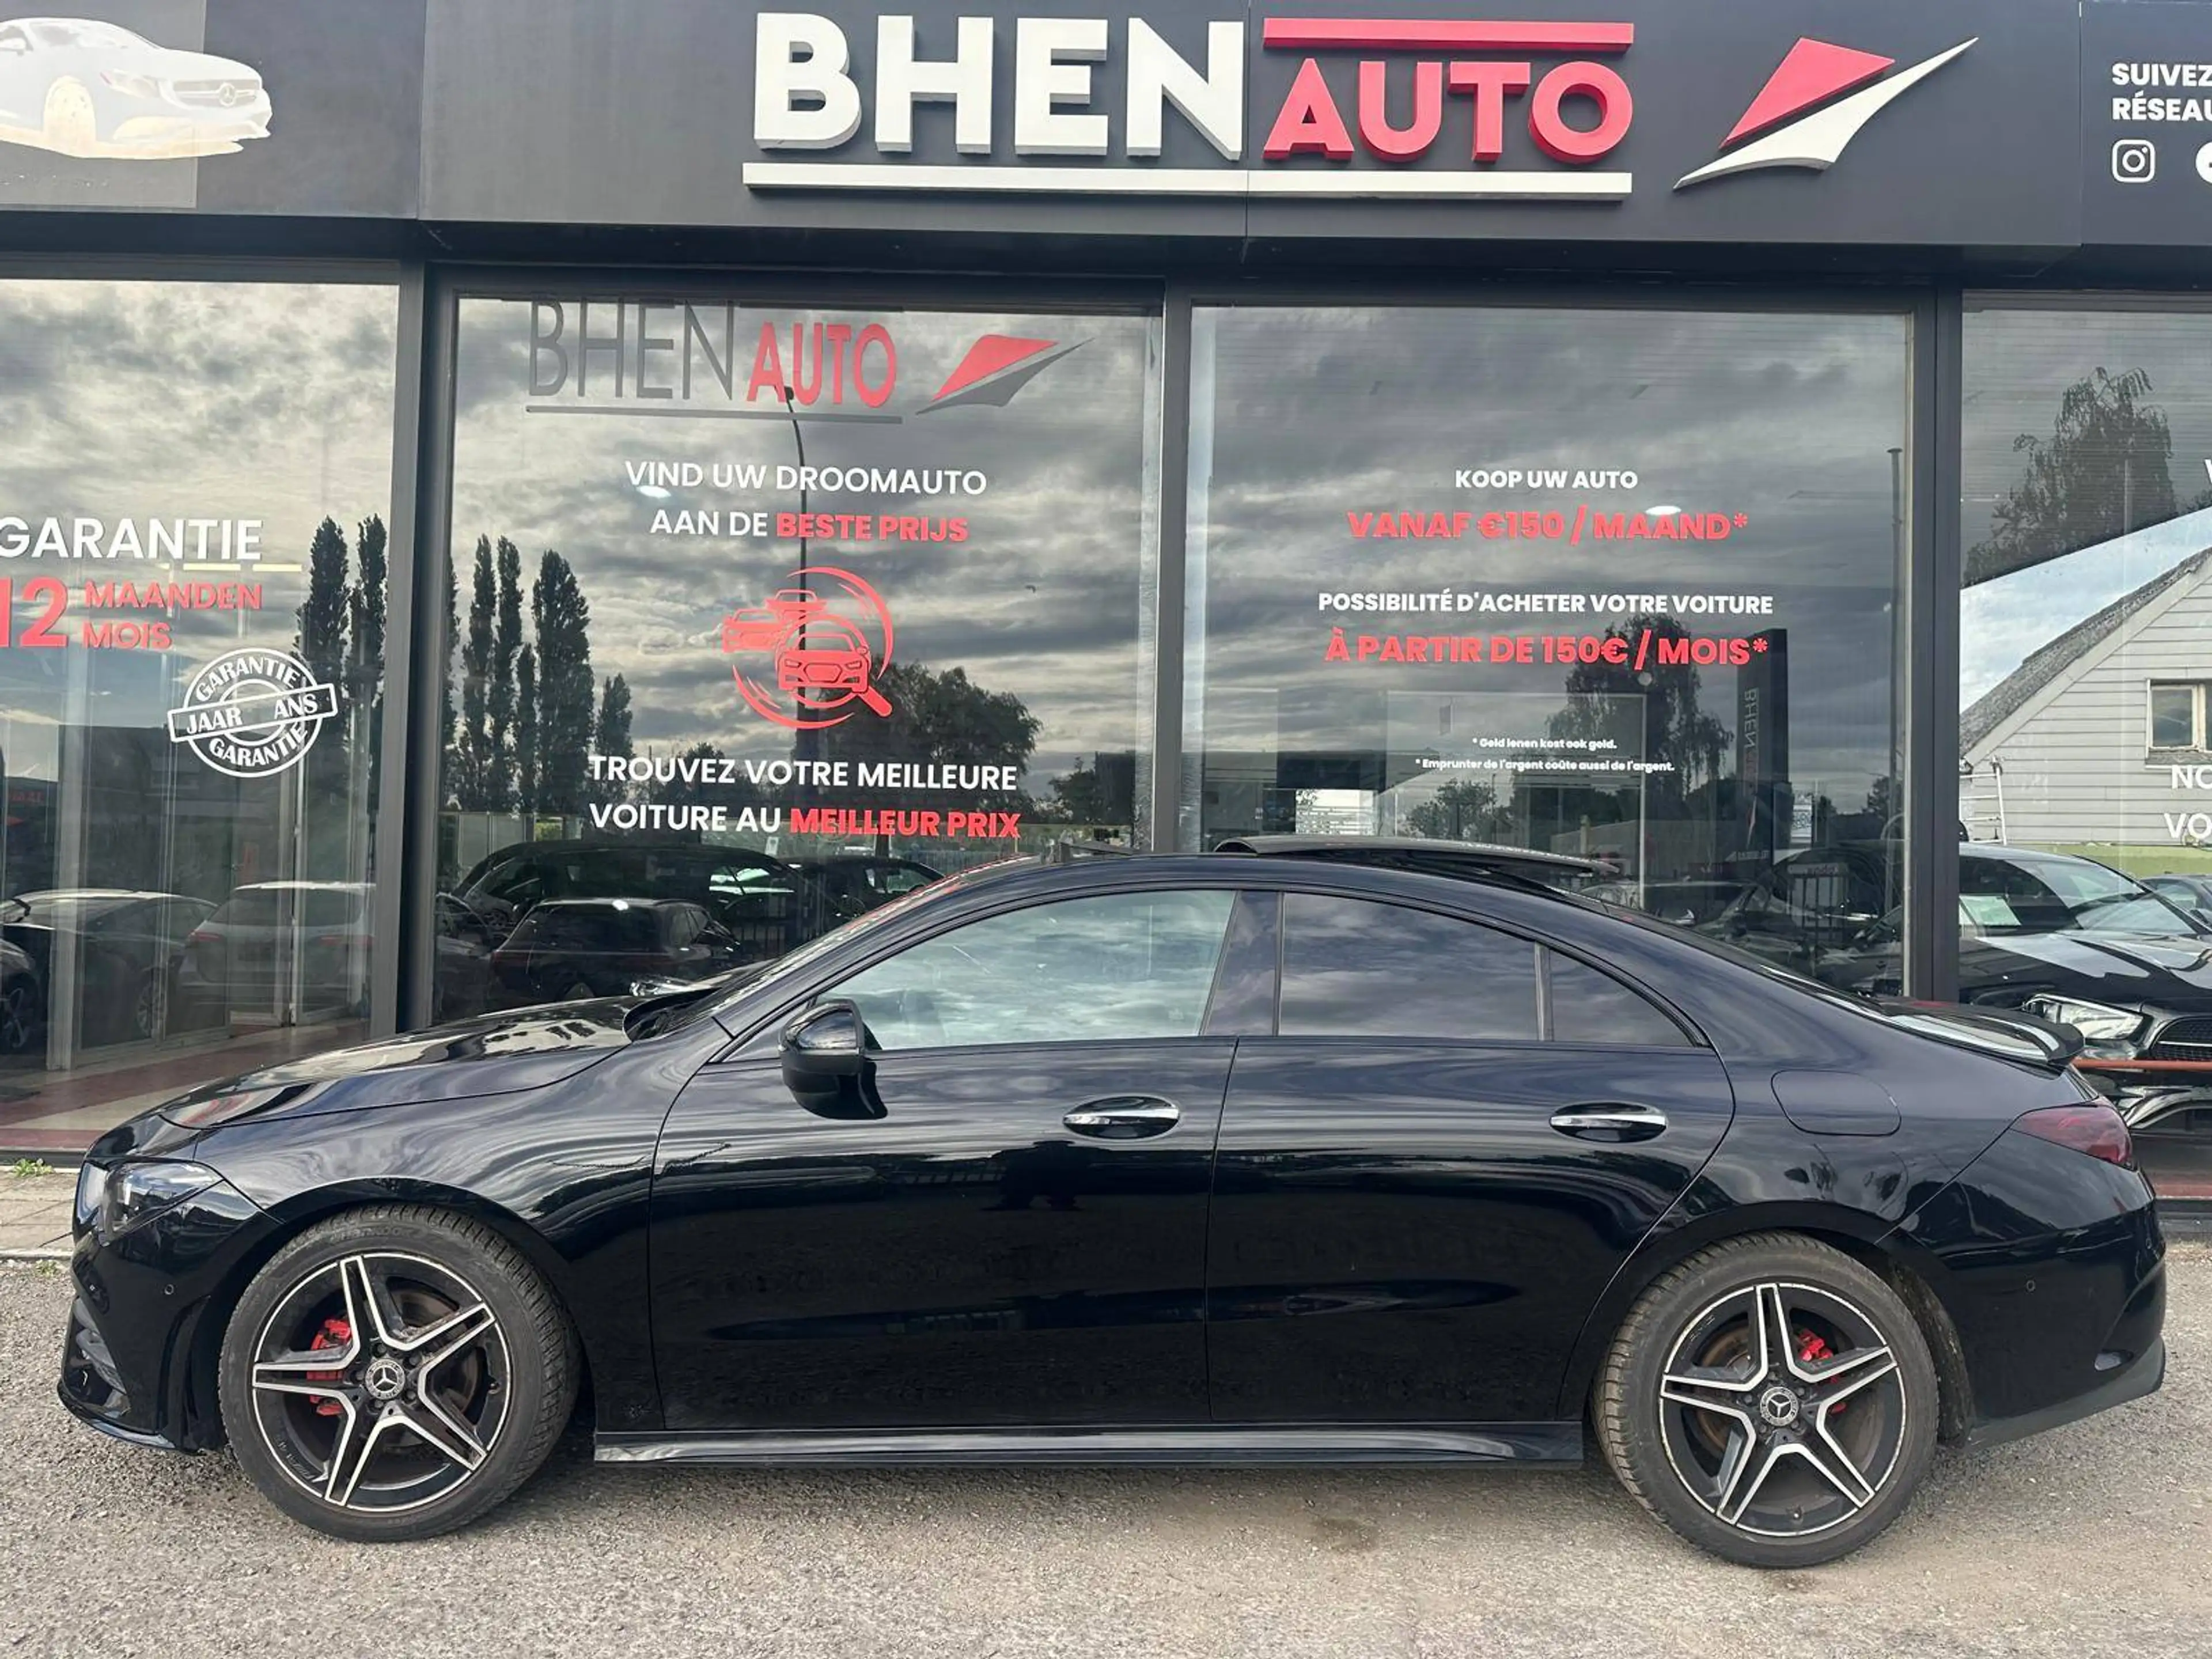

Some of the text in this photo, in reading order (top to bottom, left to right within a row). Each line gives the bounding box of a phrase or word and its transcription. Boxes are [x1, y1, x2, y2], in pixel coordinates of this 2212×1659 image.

[754, 12, 1634, 164] BHEN AUTO
[529, 298, 896, 408] BHEN AUTO
[625, 460, 987, 495] VIND UW DROOMAUTO
[1455, 470, 1638, 488] KOOP UW AUTO
[0, 516, 263, 560] GARANTIE
[650, 509, 969, 543] AAN DE BESTE PRIJS
[1347, 510, 1472, 539] VANAF
[1477, 510, 1565, 540] €150
[85, 582, 263, 609] MAANDEN
[1319, 588, 1774, 614] POSSIBILITÉ D'ACHETER VOTRE VOITURE
[82, 622, 173, 649] MOIS
[1325, 626, 1350, 661] À
[1357, 636, 1482, 662] PARTIR
[1490, 636, 1533, 664] DE
[1540, 635, 1628, 664] 150€
[196, 656, 300, 702] GARANTIE
[186, 693, 318, 734] JAAR ANS
[209, 721, 308, 767] GARANTIE
[588, 755, 1017, 790] TROUVEZ VOTRE MEILLEURE
[1422, 759, 1481, 771] Emprunter
[1483, 759, 1498, 770] de
[589, 803, 1022, 839] VOITURE AU MEILLEUR PRIX
